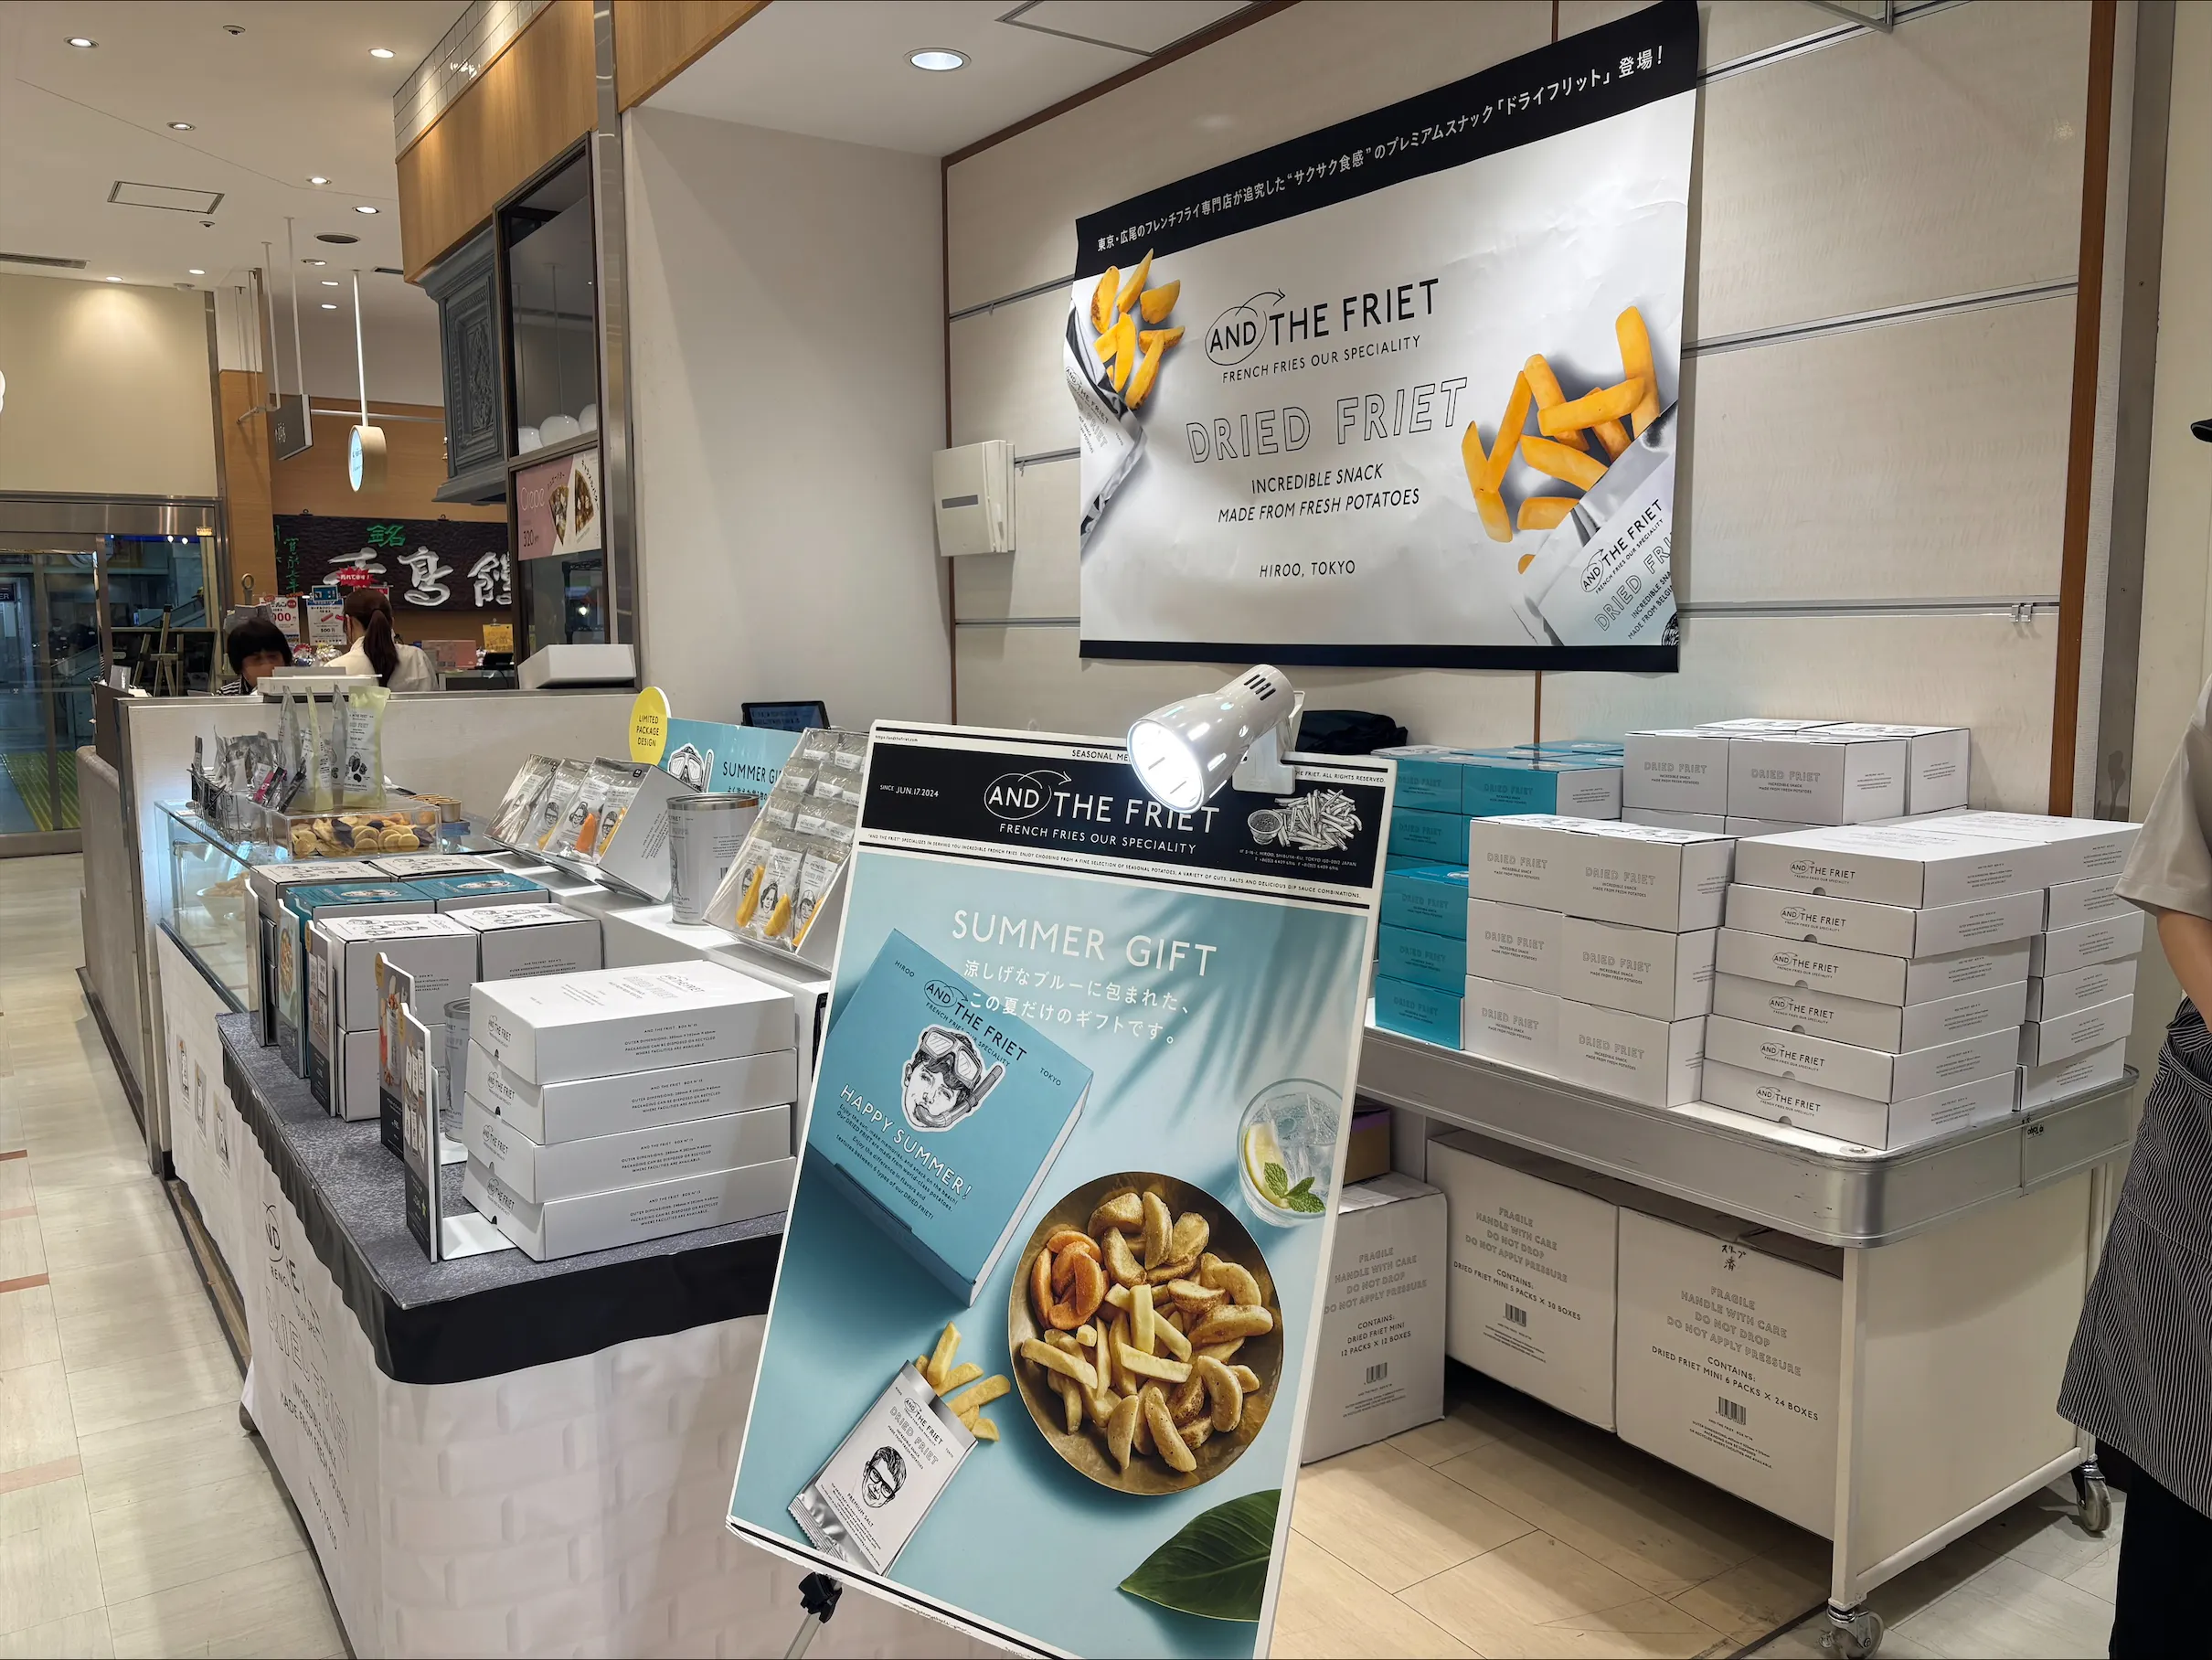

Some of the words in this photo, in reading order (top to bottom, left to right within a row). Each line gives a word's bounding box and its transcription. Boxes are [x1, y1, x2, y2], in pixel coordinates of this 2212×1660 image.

[1209, 321, 1257, 353] AND
[1269, 303, 1330, 346] THE
[1343, 278, 1439, 332] FRIET
[1223, 364, 1269, 384] FRENCH
[1273, 357, 1305, 374] FRIES
[1311, 352, 1338, 367] OUR
[1344, 335, 1420, 360] SPECIALITY
[1186, 406, 1311, 463] DRIED
[1336, 377, 1468, 445] FRIET
[1251, 471, 1332, 495] INCREDIBLE
[1336, 463, 1384, 484] SNACK
[1218, 506, 1254, 523] MADE
[1260, 503, 1295, 520] FROM
[1300, 498, 1340, 516] FRESH
[1345, 488, 1420, 510] POTATOES
[1582, 566, 1601, 590] AND
[1601, 537, 1628, 567] THE
[1627, 499, 1662, 540] FRIET
[1260, 563, 1305, 578] HIROO,
[1311, 559, 1356, 575] TOKYO
[1593, 574, 1642, 632] DRIED
[1643, 537, 1671, 574] FRI
[1632, 583, 1661, 618] INCREDIBLE
[1660, 571, 1671, 585] SNA
[1628, 622, 1643, 640] MADE
[1642, 605, 1658, 623] FROM
[1656, 585, 1673, 606] BELGI
[636, 726, 659, 736] PACKAGE
[639, 715, 659, 725] LIMITED
[637, 738, 656, 747] DESIGN
[1071, 750, 1113, 761] SEASONAL
[1116, 753, 1131, 761] ME
[723, 761, 766, 782] SUMMER
[1334, 773, 1354, 782] RIGHTS
[988, 786, 1040, 809] AND
[1053, 791, 1114, 822] THE
[1125, 798, 1220, 833] FRIET
[999, 824, 1048, 838] FRENCH
[1053, 829, 1086, 842] FRIES
[1090, 833, 1117, 846] OUR
[1122, 836, 1196, 855] SPECIALITY
[1586, 867, 1618, 880] DRIED
[1624, 872, 1655, 885] FRIET
[1810, 866, 1826, 875] THE
[1830, 868, 1856, 878] FRIET
[952, 909, 1104, 961] SUMMER
[1126, 934, 1217, 977] GIFT
[894, 959, 915, 978] HIROO
[1583, 952, 1615, 965] DRIED
[1620, 958, 1651, 973] FRIET
[964, 959, 1189, 1014] 涼しげなブルーに包まれた、
[926, 1002, 949, 1021] FRENCH
[927, 984, 951, 1004] AND
[954, 1002, 984, 1031] THE
[984, 1026, 1027, 1060] FRIET
[969, 991, 1175, 1045] この夏だけのギフトです。
[978, 1042, 1010, 1067] SPECIALITY
[1039, 1067, 1062, 1087] TOKYO
[1757, 1090, 1771, 1098] AND
[1775, 1094, 1792, 1104] THE
[1795, 1099, 1821, 1112] FRIET
[840, 1084, 894, 1133] HAPPY
[893, 1129, 973, 1200] SUMMER!
[1476, 1212, 1508, 1231] HANDLE
[1510, 1225, 1532, 1240] WITH
[1535, 1235, 1558, 1250] CARE
[1499, 1207, 1533, 1227] FRAGILE
[1487, 1229, 1499, 1240] DO
[1502, 1236, 1519, 1249] NOT
[1465, 1235, 1477, 1245] DO
[1480, 1240, 1497, 1253] NOT
[1499, 1249, 1523, 1264] APPLY
[1526, 1259, 1568, 1282] PRESSURE
[1453, 1261, 1473, 1273] DRIED
[1474, 1271, 1492, 1282] FRIET
[1494, 1278, 1508, 1289] MINI
[1515, 1288, 1537, 1302] PACKS
[1547, 1302, 1556, 1310] 30
[1558, 1306, 1580, 1320] BOXES
[1711, 1285, 1756, 1311] FRAGILE
[1357, 1314, 1395, 1329] CONTAINS:
[1681, 1291, 1723, 1314] HANDLE
[1726, 1307, 1754, 1326] WITH
[1757, 1320, 1788, 1338] CARE
[1695, 1311, 1711, 1325] DO
[1714, 1318, 1737, 1335] NOT
[1739, 1328, 1771, 1347] DROP
[1347, 1333, 1367, 1344] DRIED
[1370, 1326, 1388, 1338] FRIET
[1390, 1322, 1405, 1331] MINI
[1350, 1343, 1371, 1354] PACKS
[1390, 1331, 1411, 1342] BOXES
[1667, 1316, 1682, 1329] DO
[1686, 1324, 1707, 1338] NOT
[1710, 1334, 1742, 1353] APPLY
[1745, 1346, 1802, 1377] PRESSURE
[1652, 1346, 1675, 1361] DRIED
[1678, 1357, 1701, 1371] FRIET
[1704, 1367, 1723, 1380] MINI
[1733, 1379, 1760, 1397] PACKS
[1775, 1397, 1784, 1407] 24
[1788, 1402, 1819, 1421] BOXES
[1707, 1357, 1756, 1382] CONTAINS:
